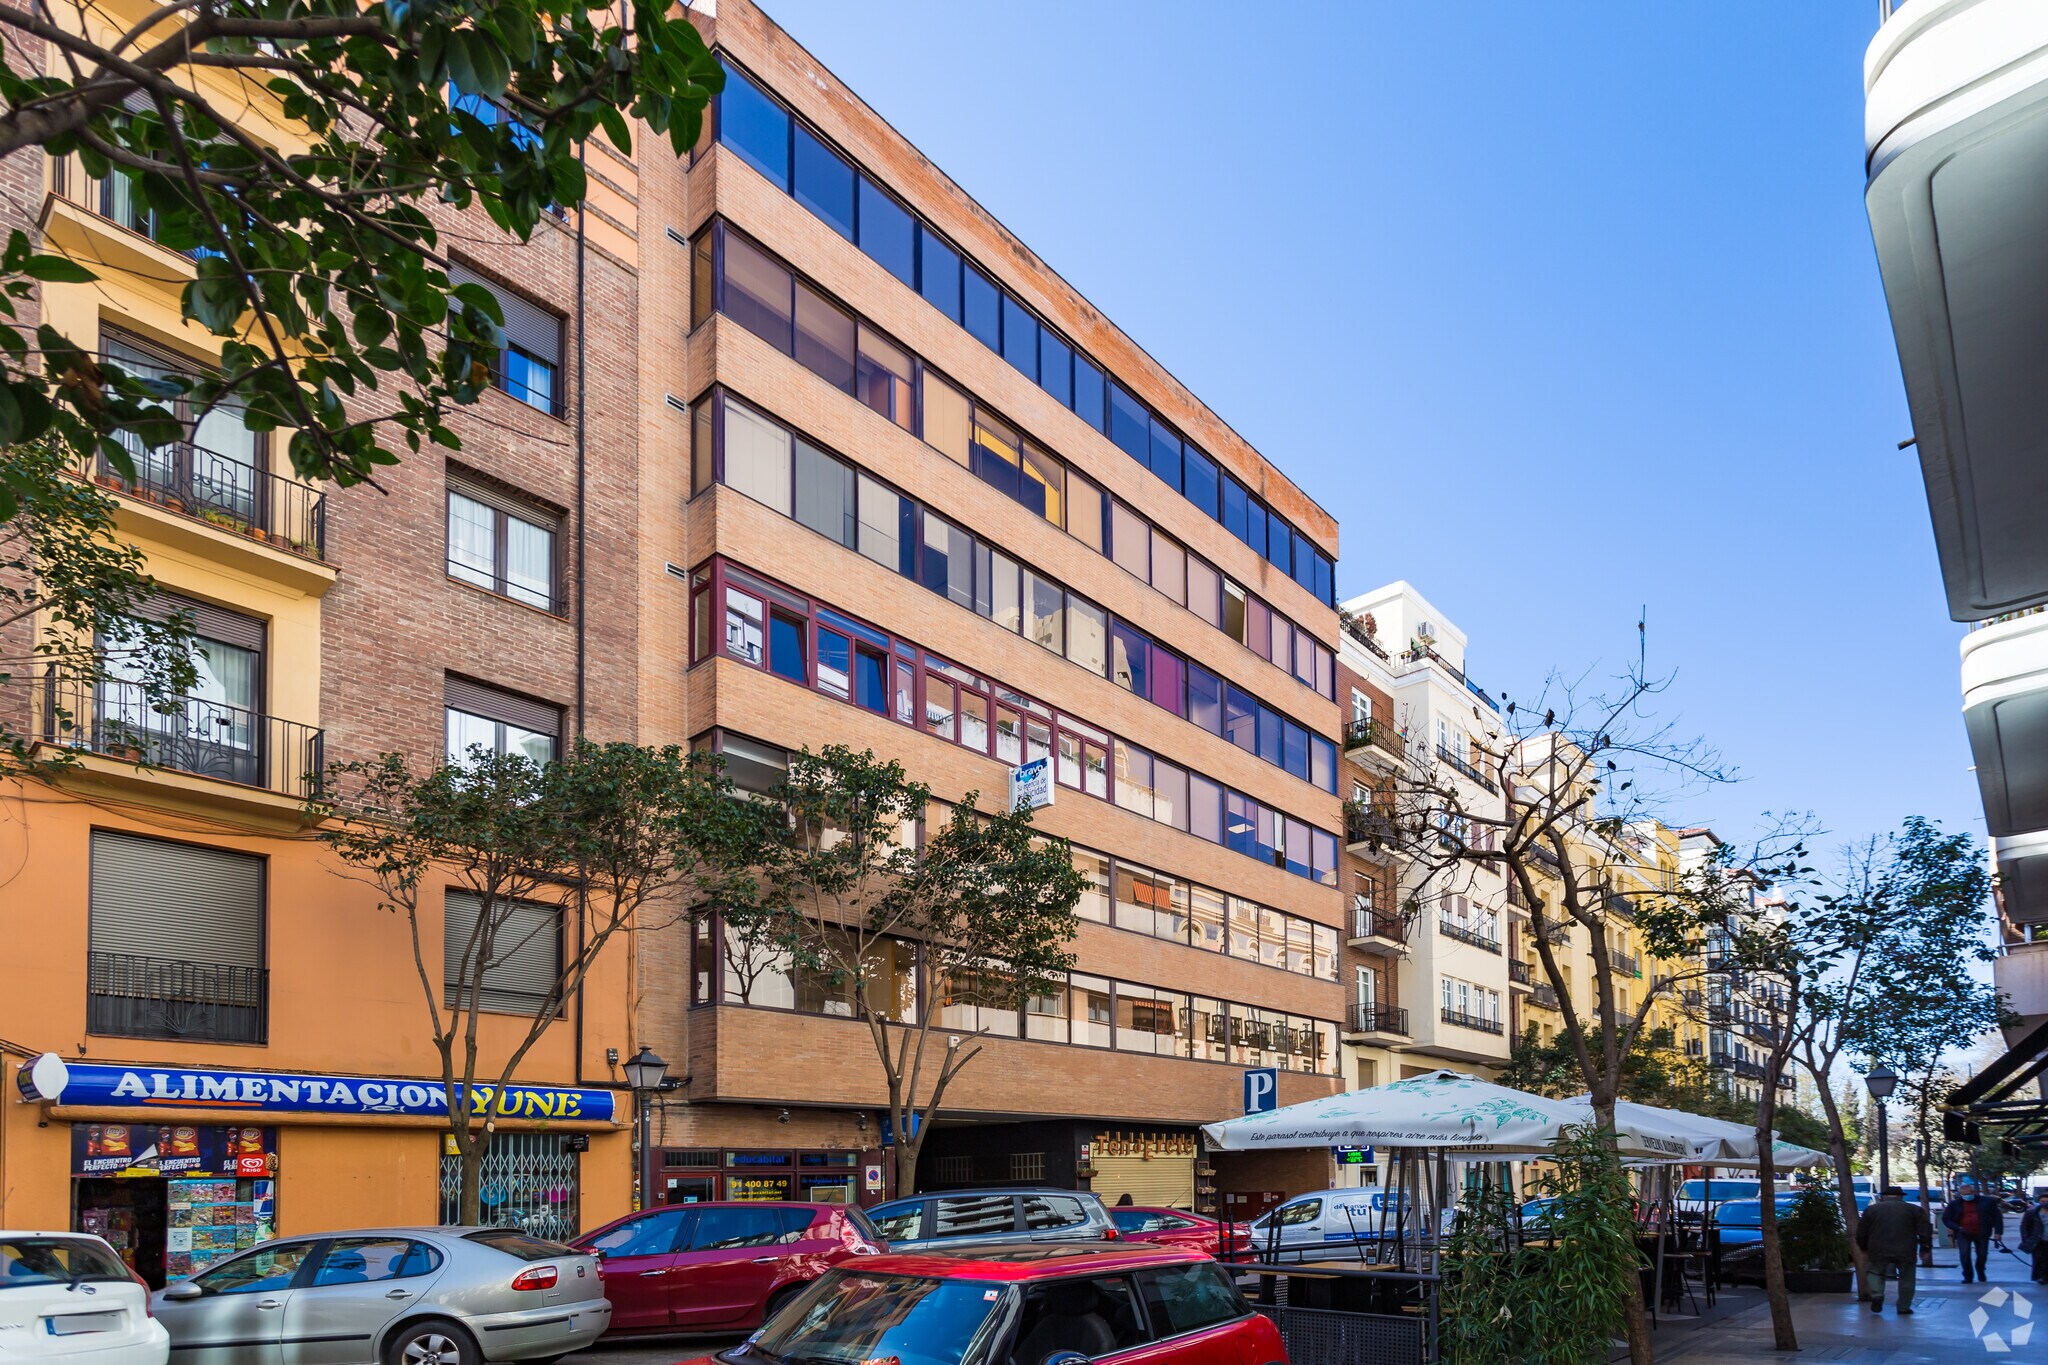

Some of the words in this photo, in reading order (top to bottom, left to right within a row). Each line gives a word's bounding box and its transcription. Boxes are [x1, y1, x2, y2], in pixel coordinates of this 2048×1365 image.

[1020, 764, 1044, 778] bravo
[110, 1072, 449, 1108] ALIMENTACION
[470, 1087, 582, 1117] YUNE
[1247, 1072, 1273, 1112] P
[1250, 1132, 1266, 1141] Este
[1265, 1131, 1299, 1142] parasol
[1298, 1129, 1340, 1141] contribuye
[1350, 1129, 1365, 1139] que
[1366, 1130, 1403, 1139] respires
[1405, 1132, 1426, 1140] aire
[1426, 1133, 1448, 1141] más
[93, 1157, 133, 1166] ENCUENTRO
[164, 1157, 201, 1166] ENCUENTRO
[83, 1164, 118, 1172] PERFECTO
[745, 1180, 762, 1188] 400
[763, 1180, 774, 1188] 87
